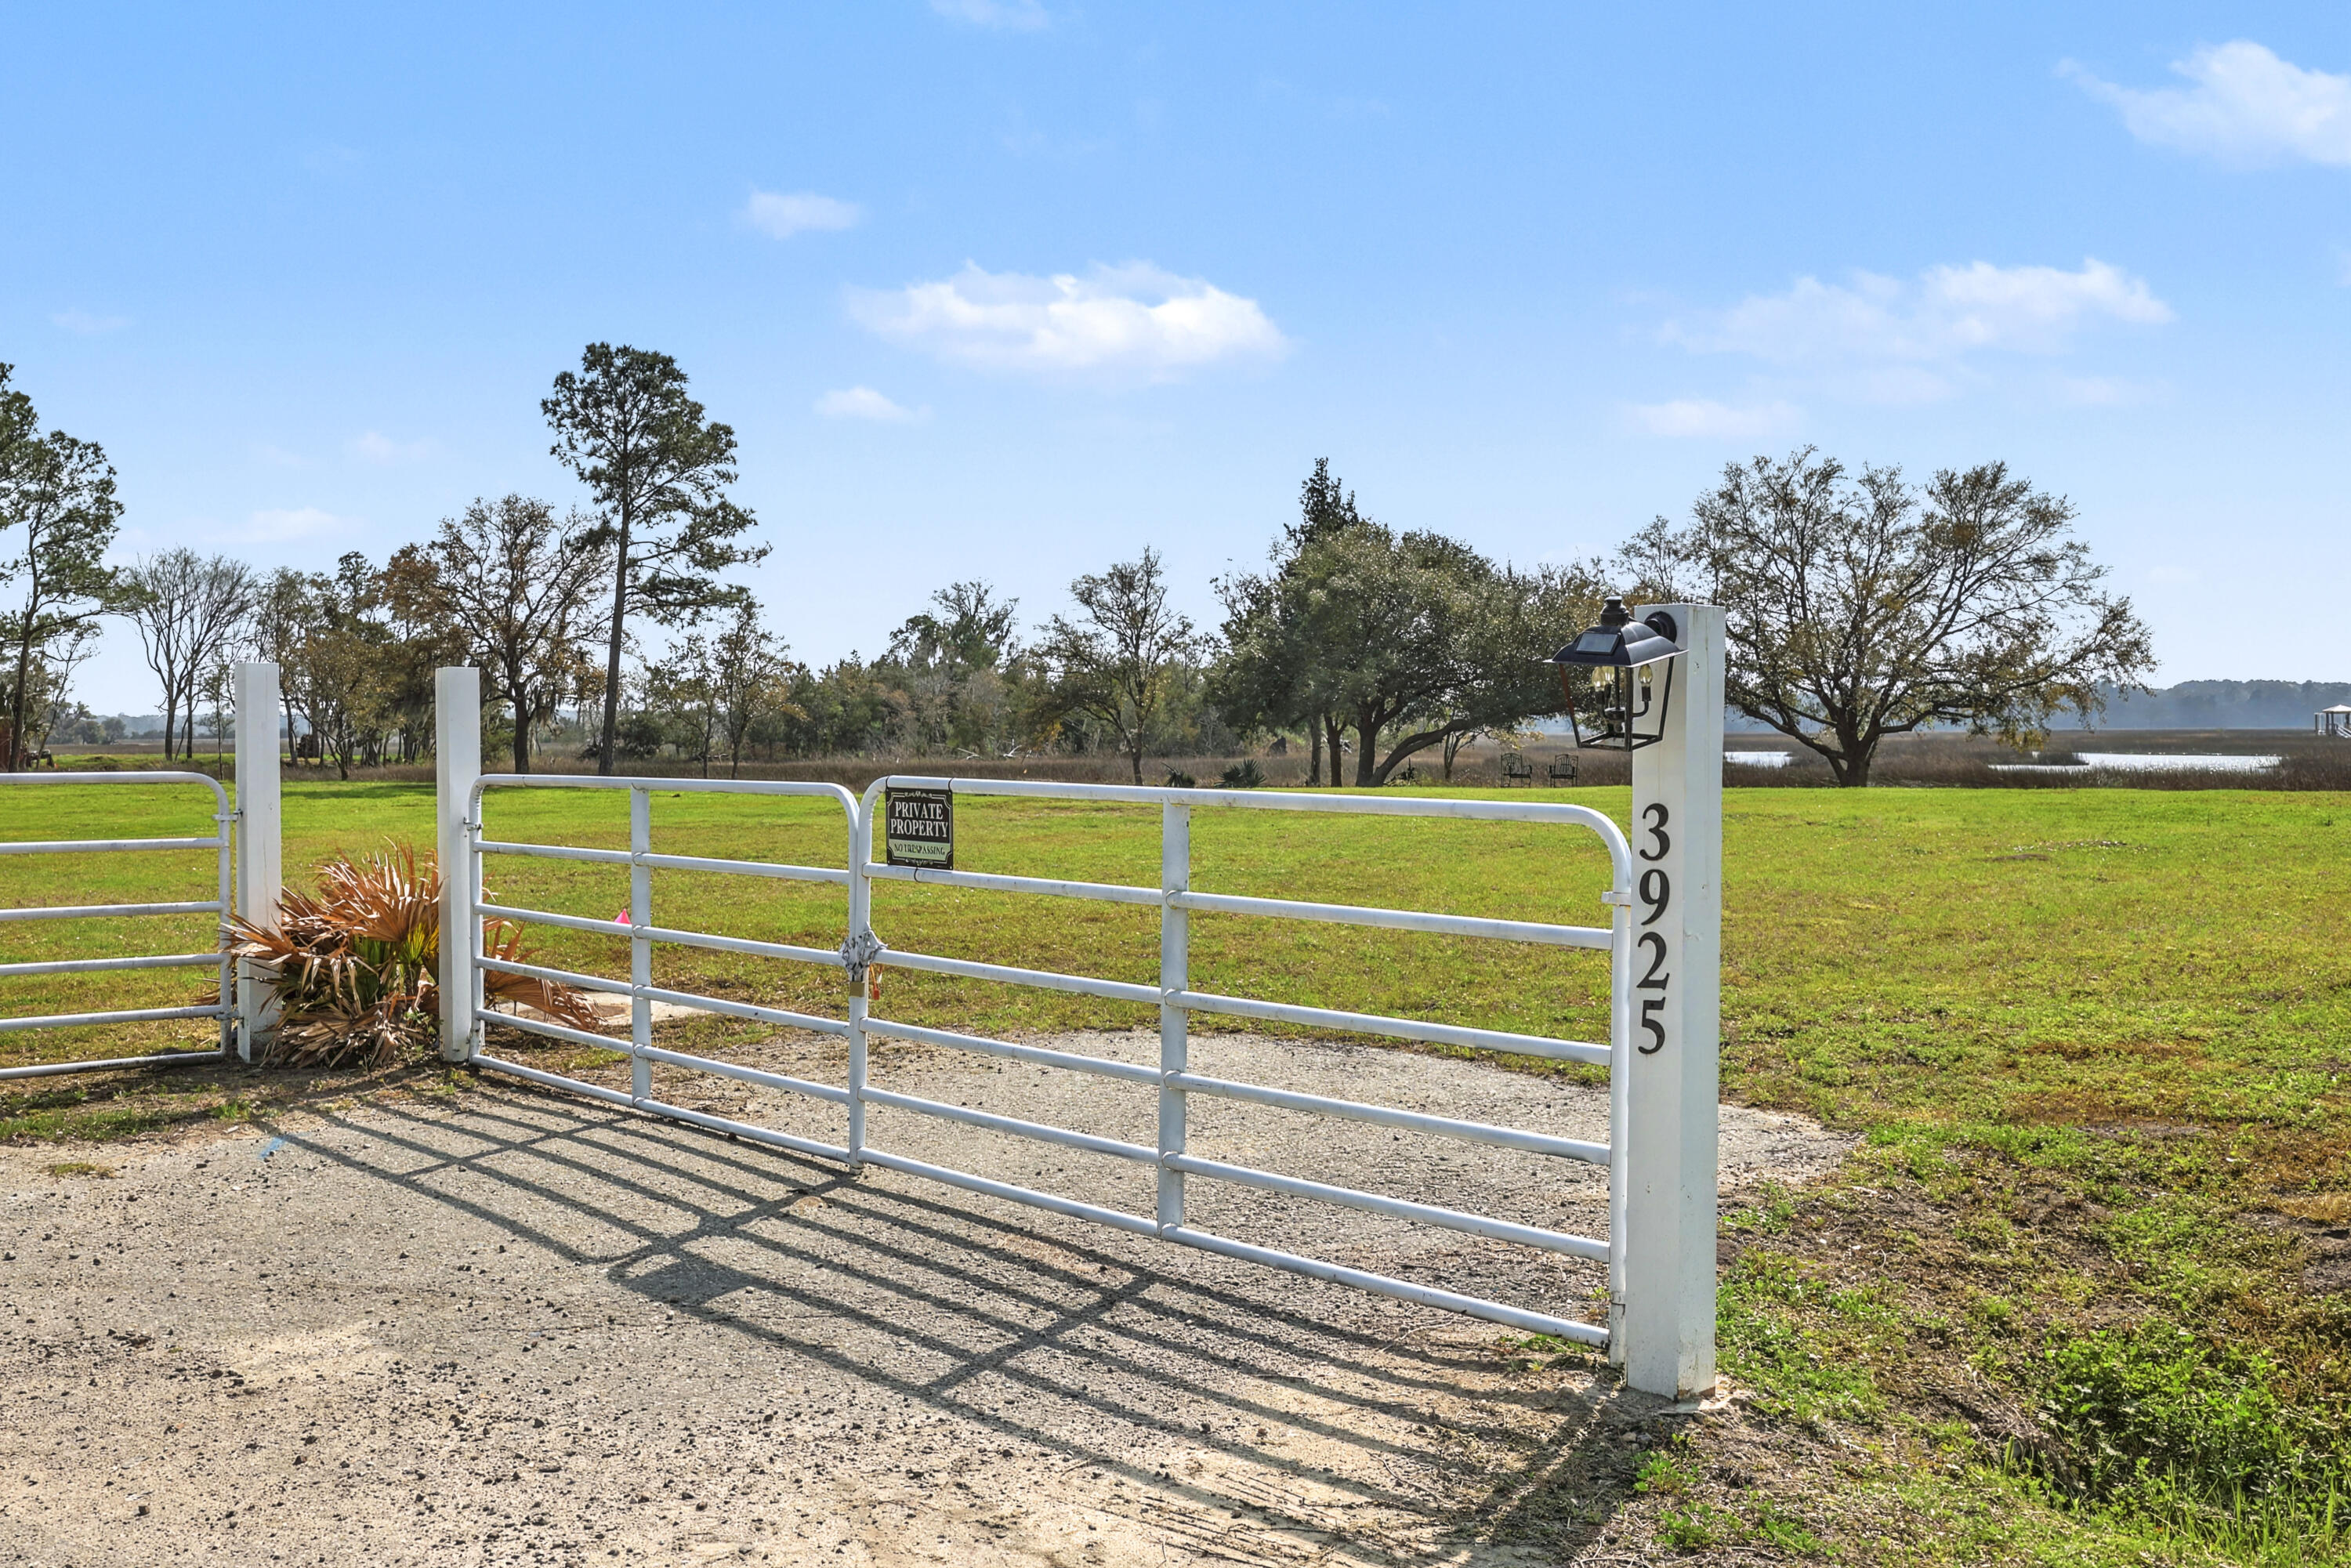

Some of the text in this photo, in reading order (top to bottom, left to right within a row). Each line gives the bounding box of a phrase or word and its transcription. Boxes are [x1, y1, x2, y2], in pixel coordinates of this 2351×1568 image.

[895, 801, 944, 820] PRIVATE
[890, 818, 948, 838] PROPERTY
[894, 843, 945, 856] NO TRESPASSING
[1636, 802, 1671, 1055] 3925
